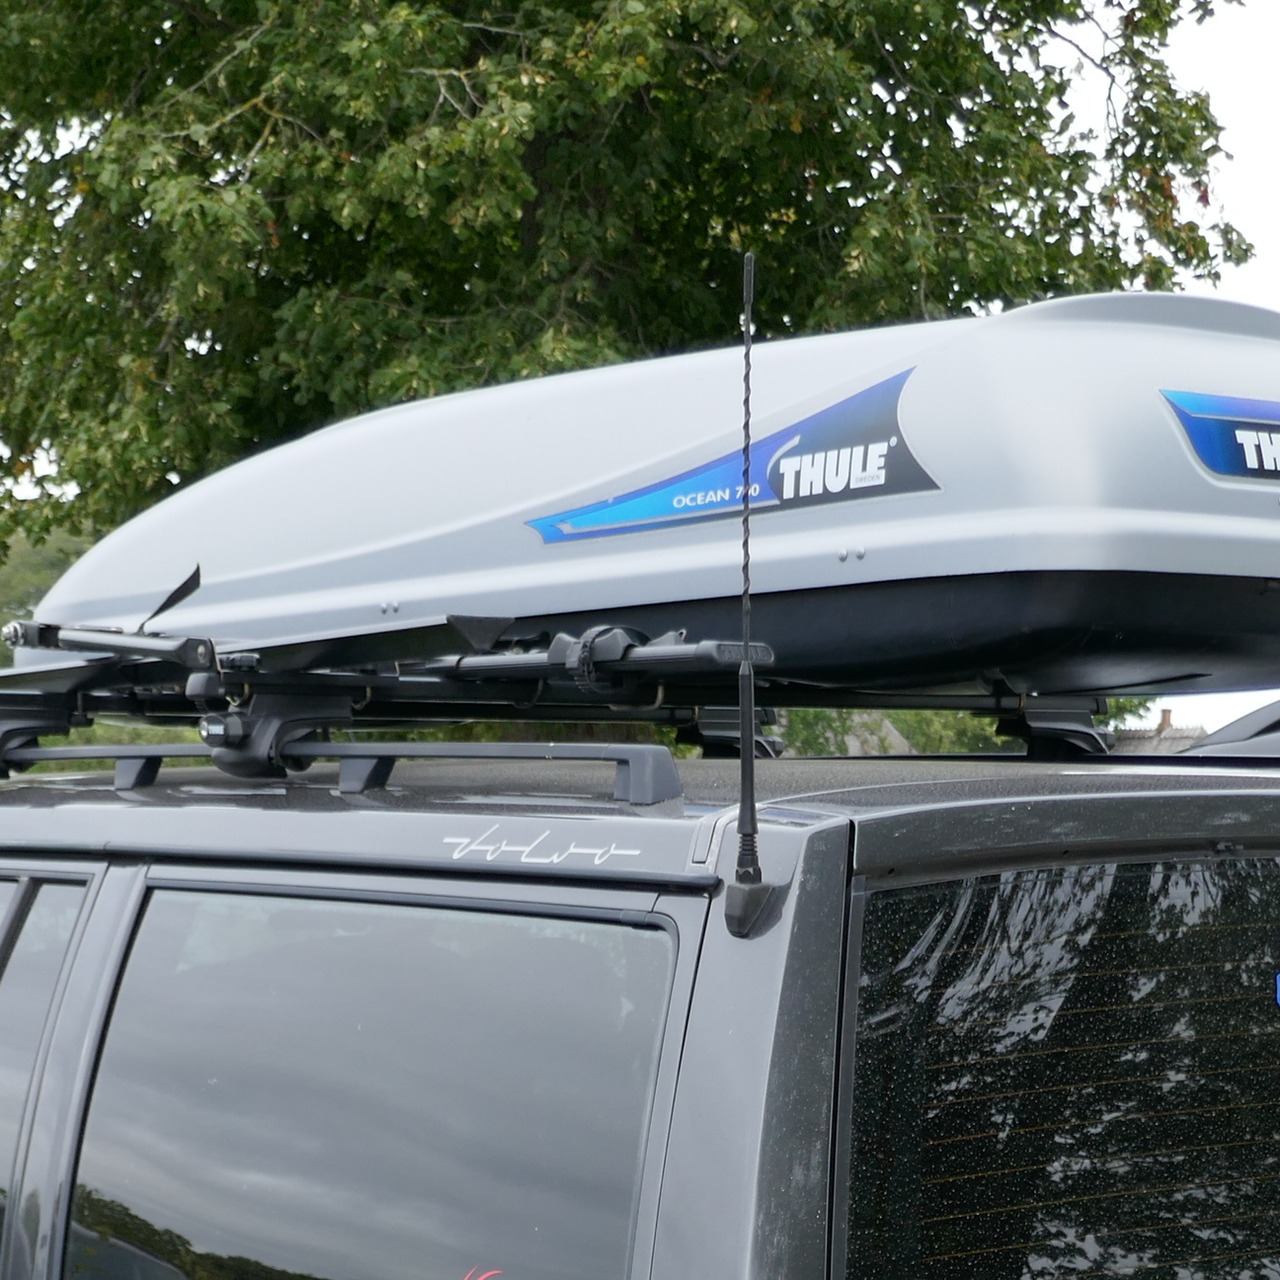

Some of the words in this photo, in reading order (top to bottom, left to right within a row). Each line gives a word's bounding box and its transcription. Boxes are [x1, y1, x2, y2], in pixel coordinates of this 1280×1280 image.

[779, 442, 888, 500] THULE
[854, 474, 881, 486] SWEDEN
[672, 487, 730, 509] OCEAN
